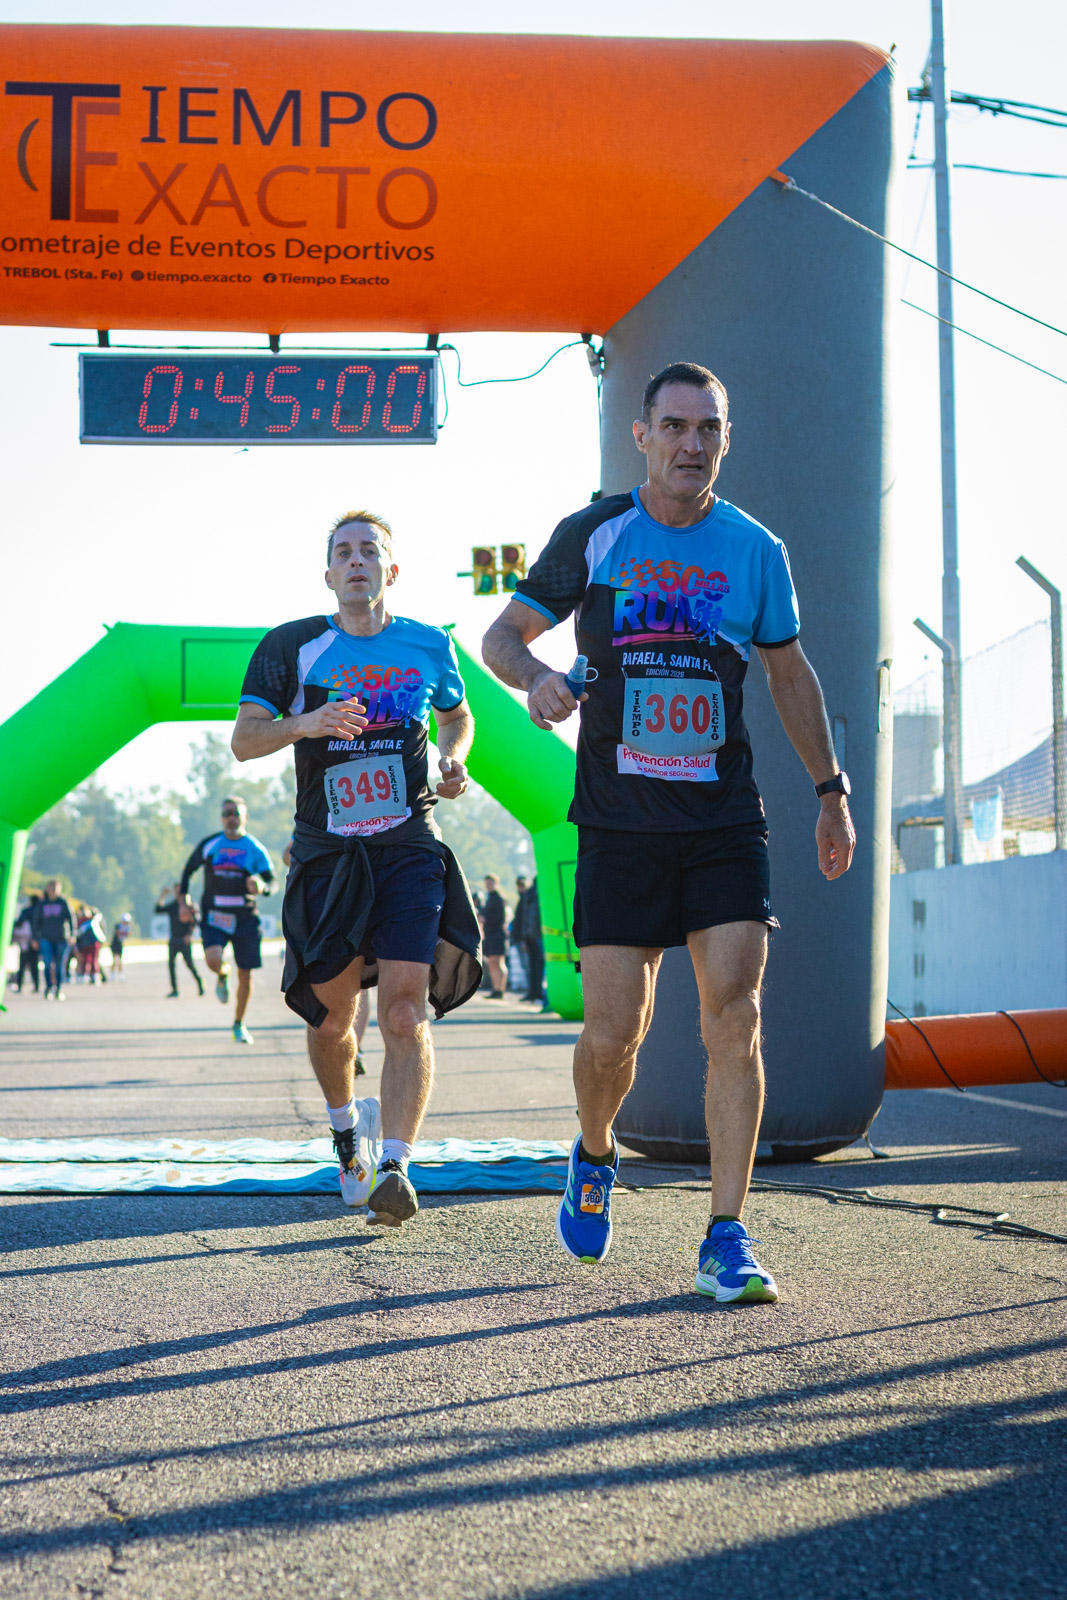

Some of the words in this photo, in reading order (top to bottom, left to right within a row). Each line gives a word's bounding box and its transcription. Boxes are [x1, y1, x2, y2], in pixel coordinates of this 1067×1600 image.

[128, 234, 160, 256] de
[170, 236, 275, 258] Eventos
[285, 238, 435, 264] Deportivos
[3, 267, 61, 278] TREBOL
[65, 268, 98, 280] (Sta.
[101, 269, 123, 281] Fe)
[147, 269, 252, 284] tiempo.exacto
[279, 273, 337, 286] Tiempo
[340, 274, 390, 286] Exacto
[138, 365, 427, 434] 0:45:00
[657, 560, 728, 602] 500
[694, 579, 731, 594] MILLAS
[613, 590, 707, 634] RUN
[622, 652, 667, 667] RAFAELA,
[669, 654, 701, 669] SANTA
[632, 690, 642, 737] TIEMPO
[645, 692, 711, 735] 360
[710, 692, 720, 741] EXACTO
[328, 740, 367, 752] RAFAELA,
[622, 748, 681, 767] Prevención
[683, 756, 711, 768] Salud
[328, 778, 340, 816] TIEMPO
[337, 769, 392, 809] 349
[388, 765, 400, 804] EXACTO
